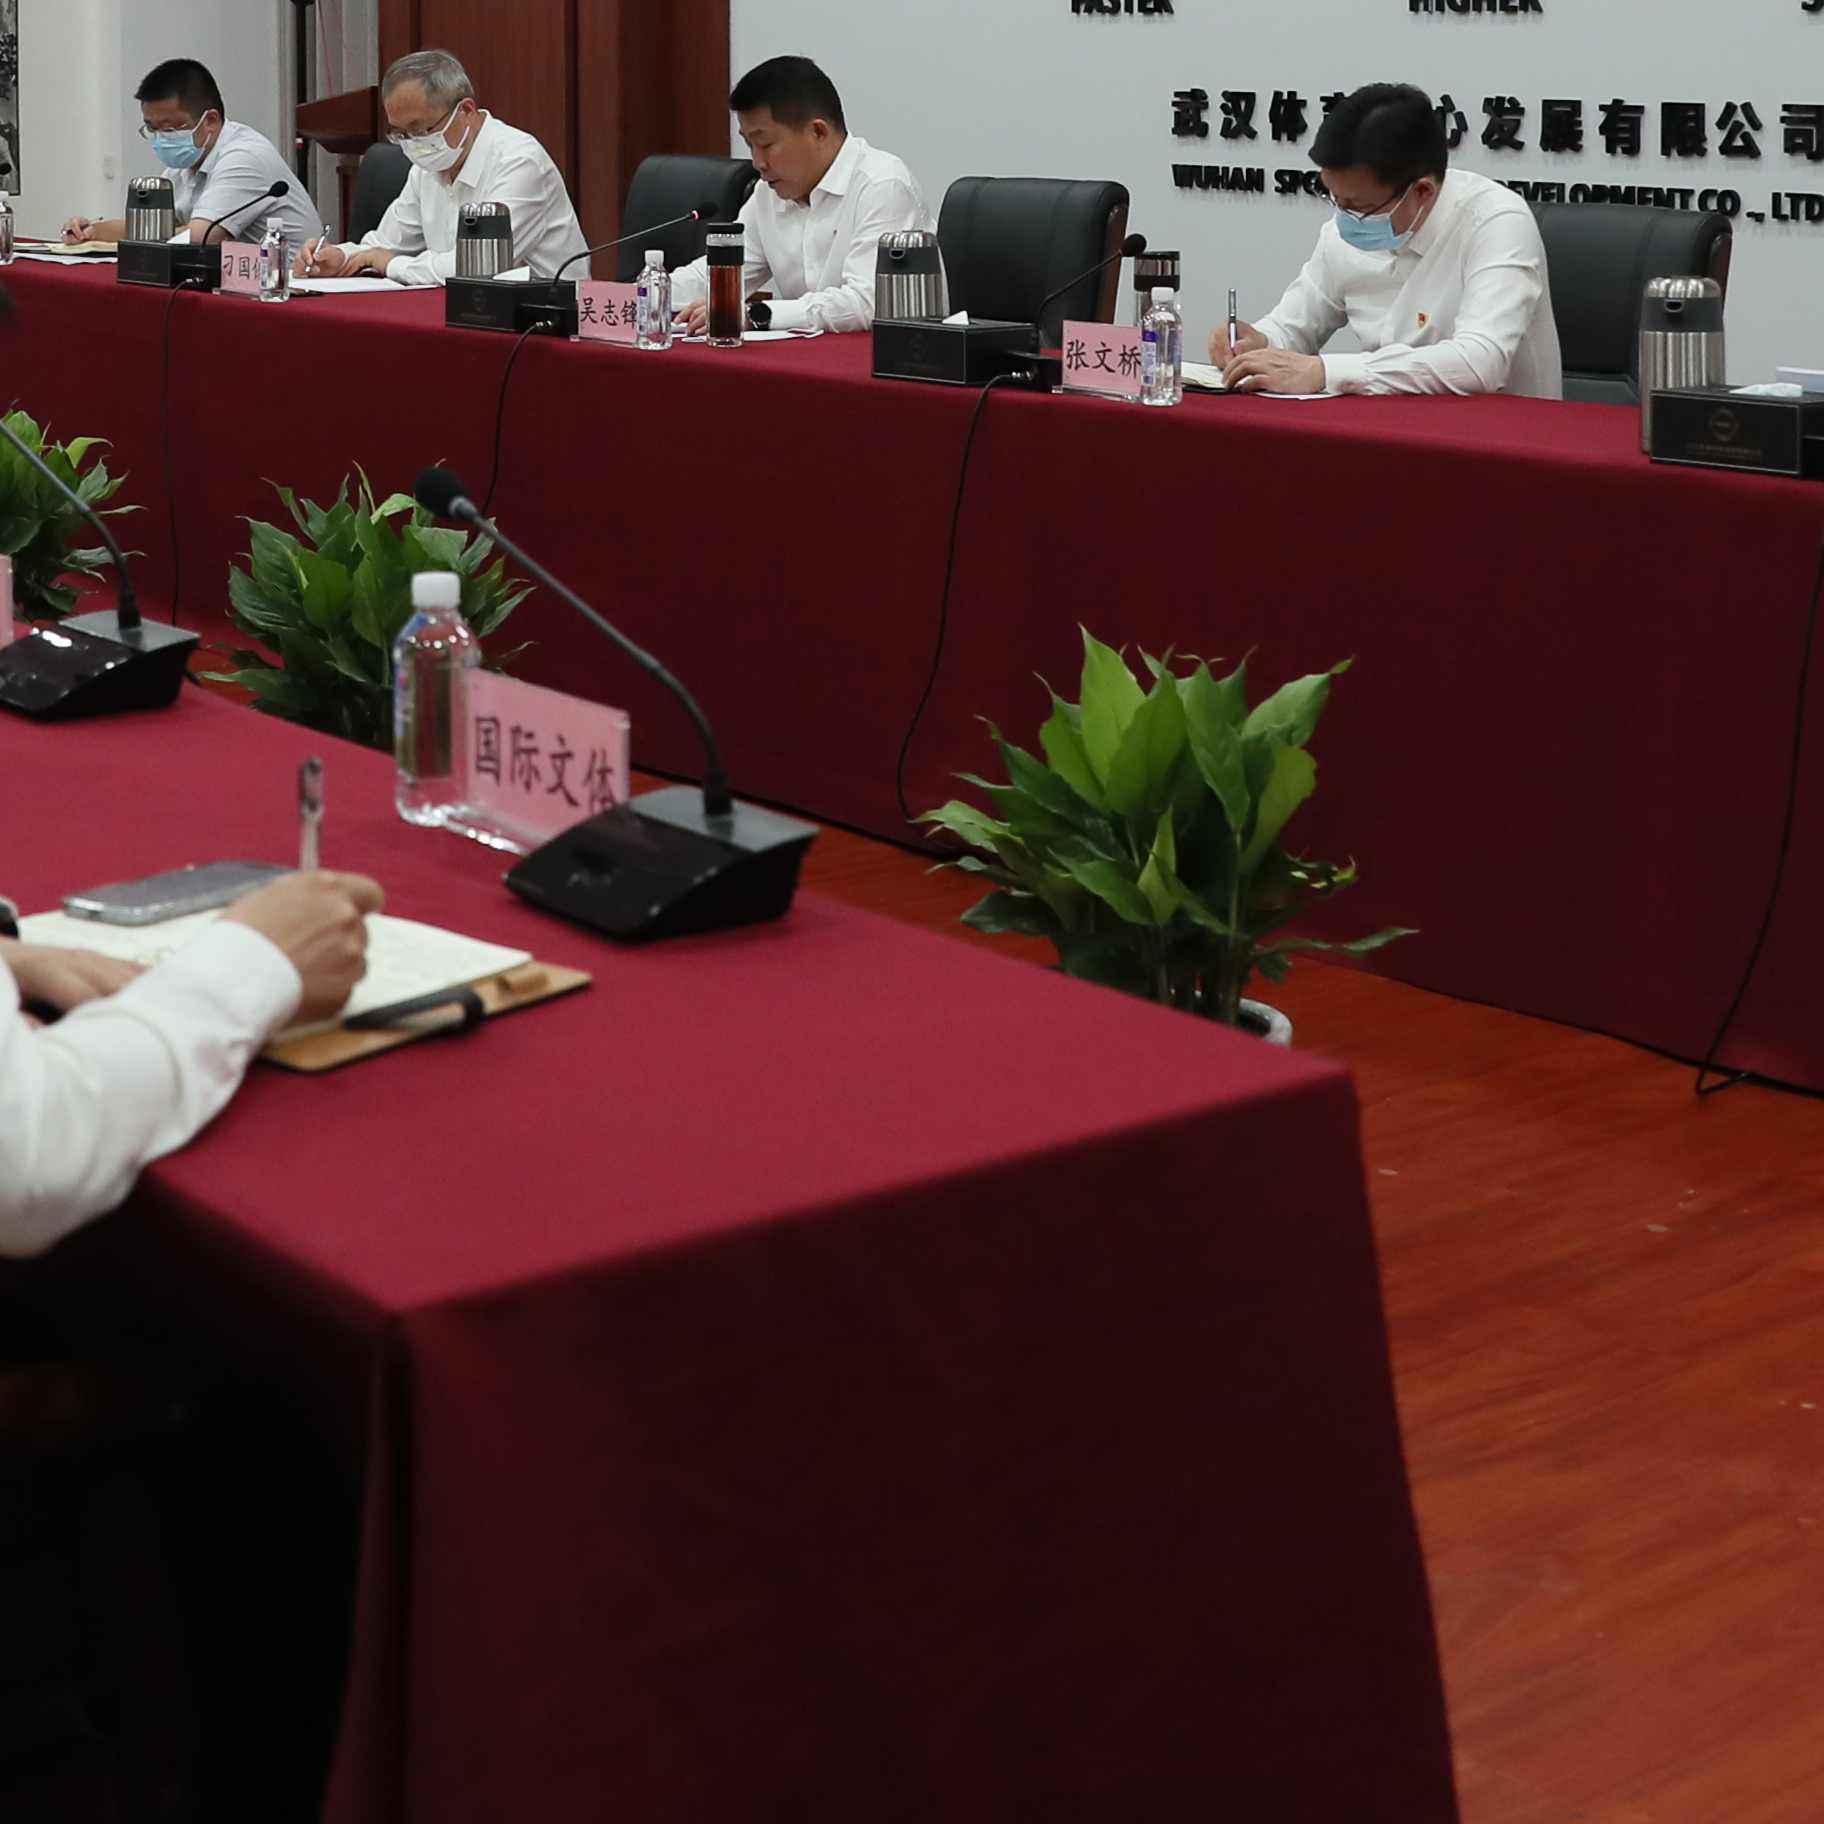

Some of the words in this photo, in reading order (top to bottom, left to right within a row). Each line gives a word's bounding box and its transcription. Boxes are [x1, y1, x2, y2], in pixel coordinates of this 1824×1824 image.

[1172, 164, 1264, 193] WUHAN
[1066, 339, 1142, 379] 张文桥
[475, 716, 617, 815] 国际文体
